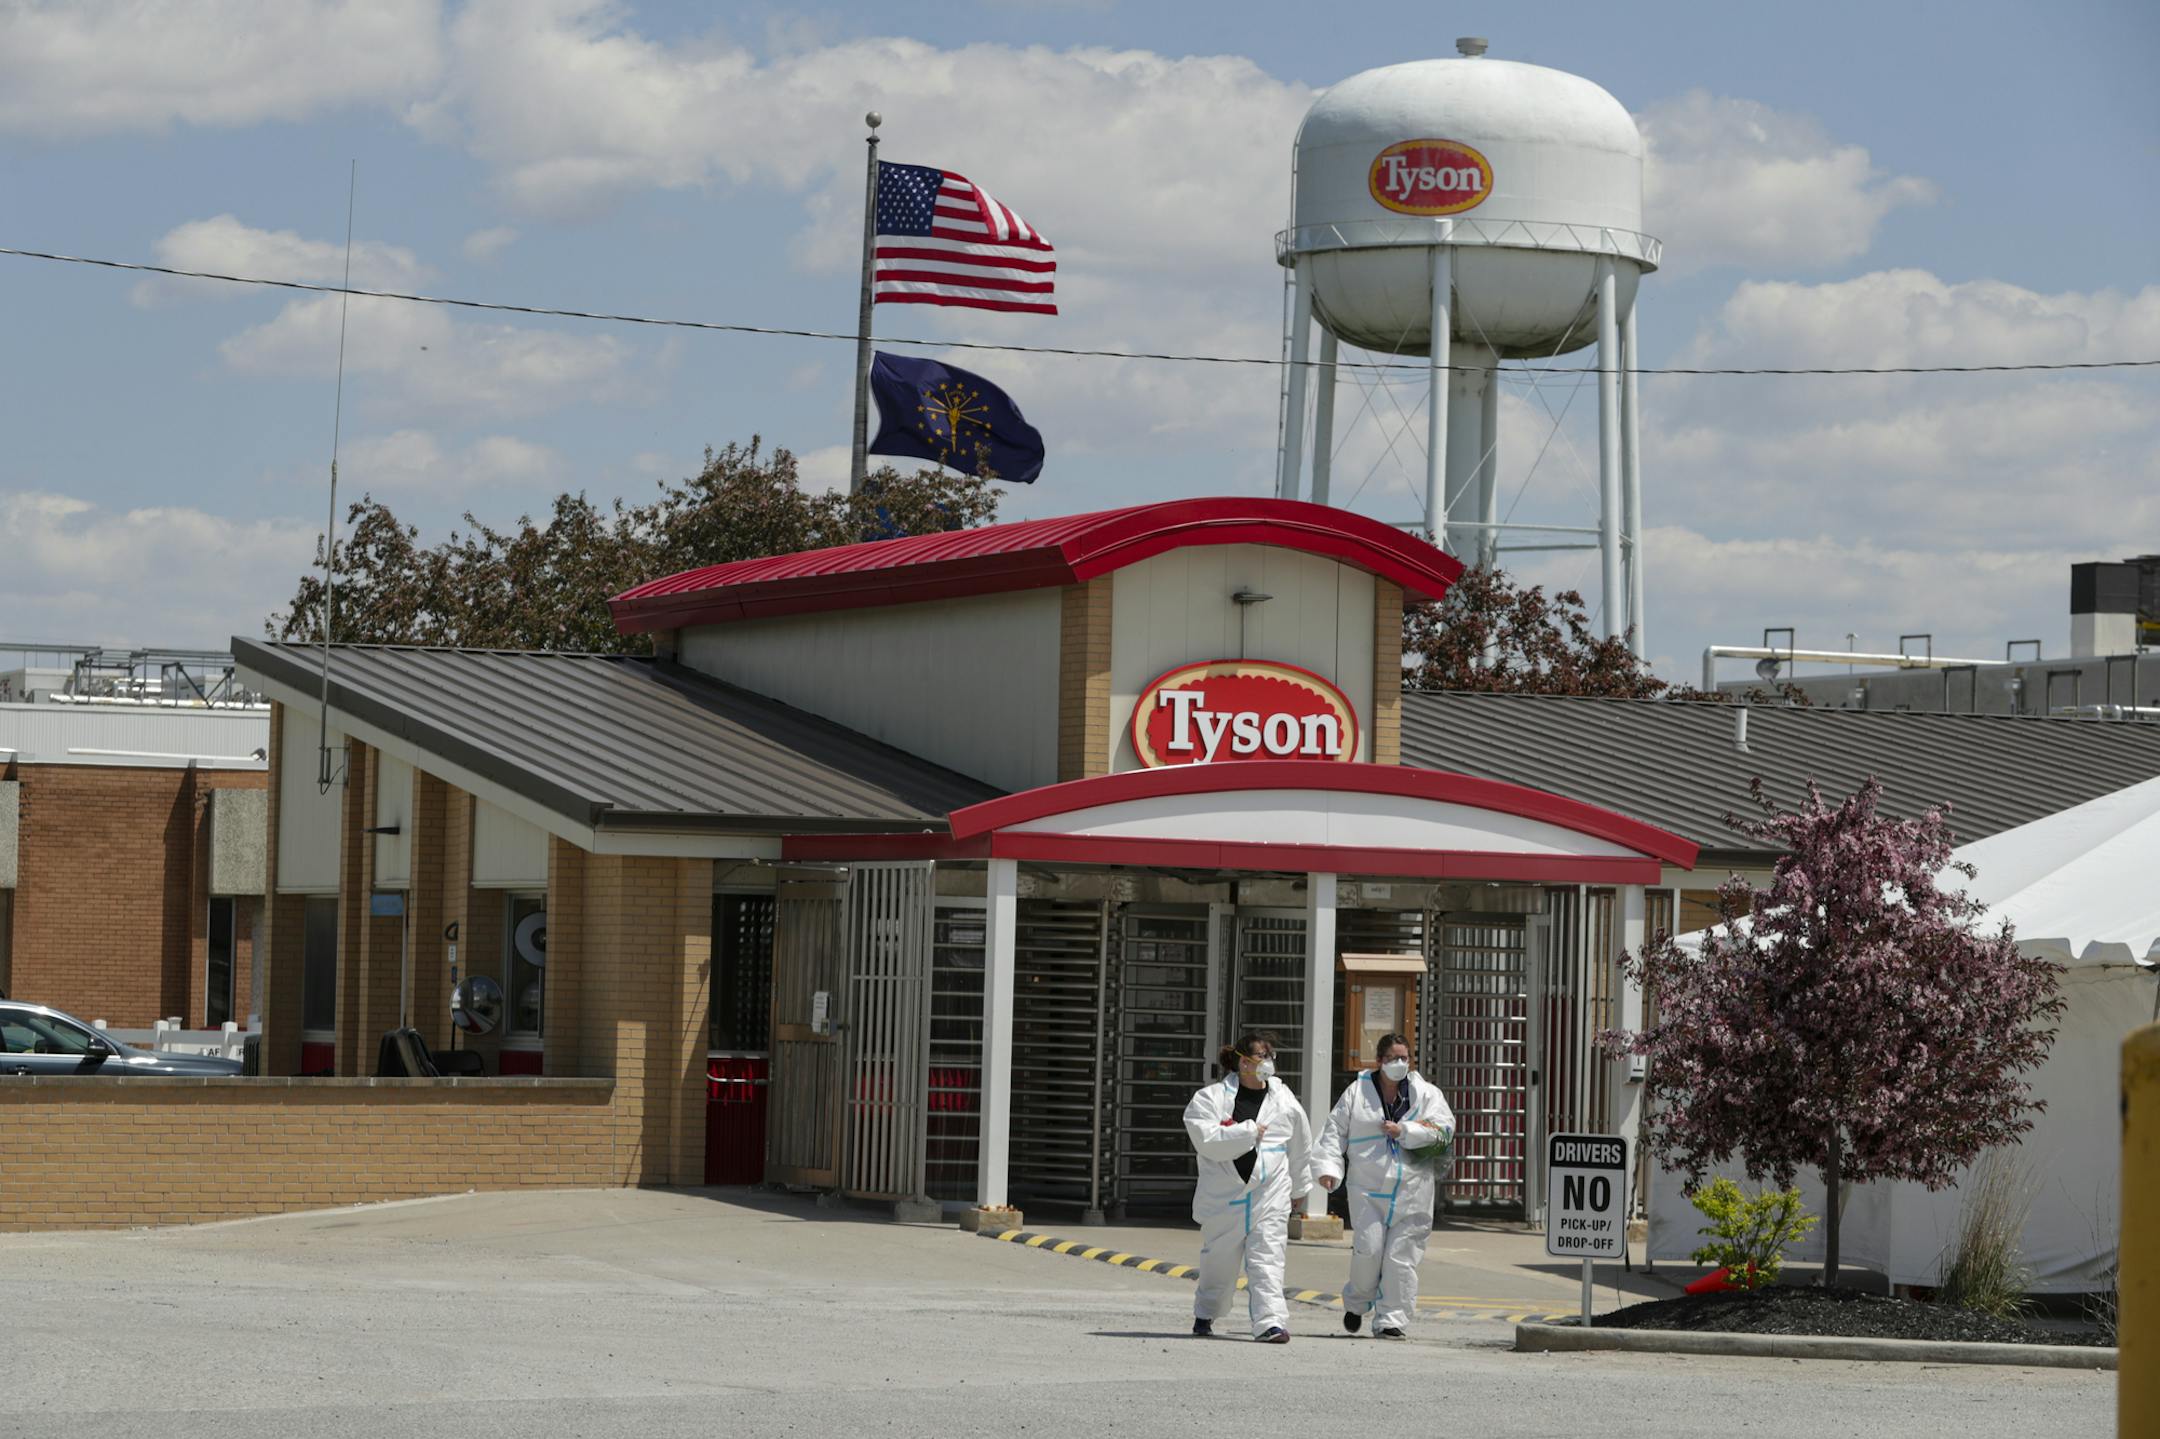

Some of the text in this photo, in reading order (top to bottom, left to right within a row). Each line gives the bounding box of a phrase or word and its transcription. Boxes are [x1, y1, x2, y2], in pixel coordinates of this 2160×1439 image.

[1382, 155, 1483, 201] Tyson
[1159, 689, 1342, 764] Tyson
[1554, 1142, 1621, 1164] DRIVERS
[1563, 1175, 1611, 1212] NO
[1561, 1218, 1612, 1231] PICK-UP/
[1557, 1235, 1614, 1250] DROP-OFF
